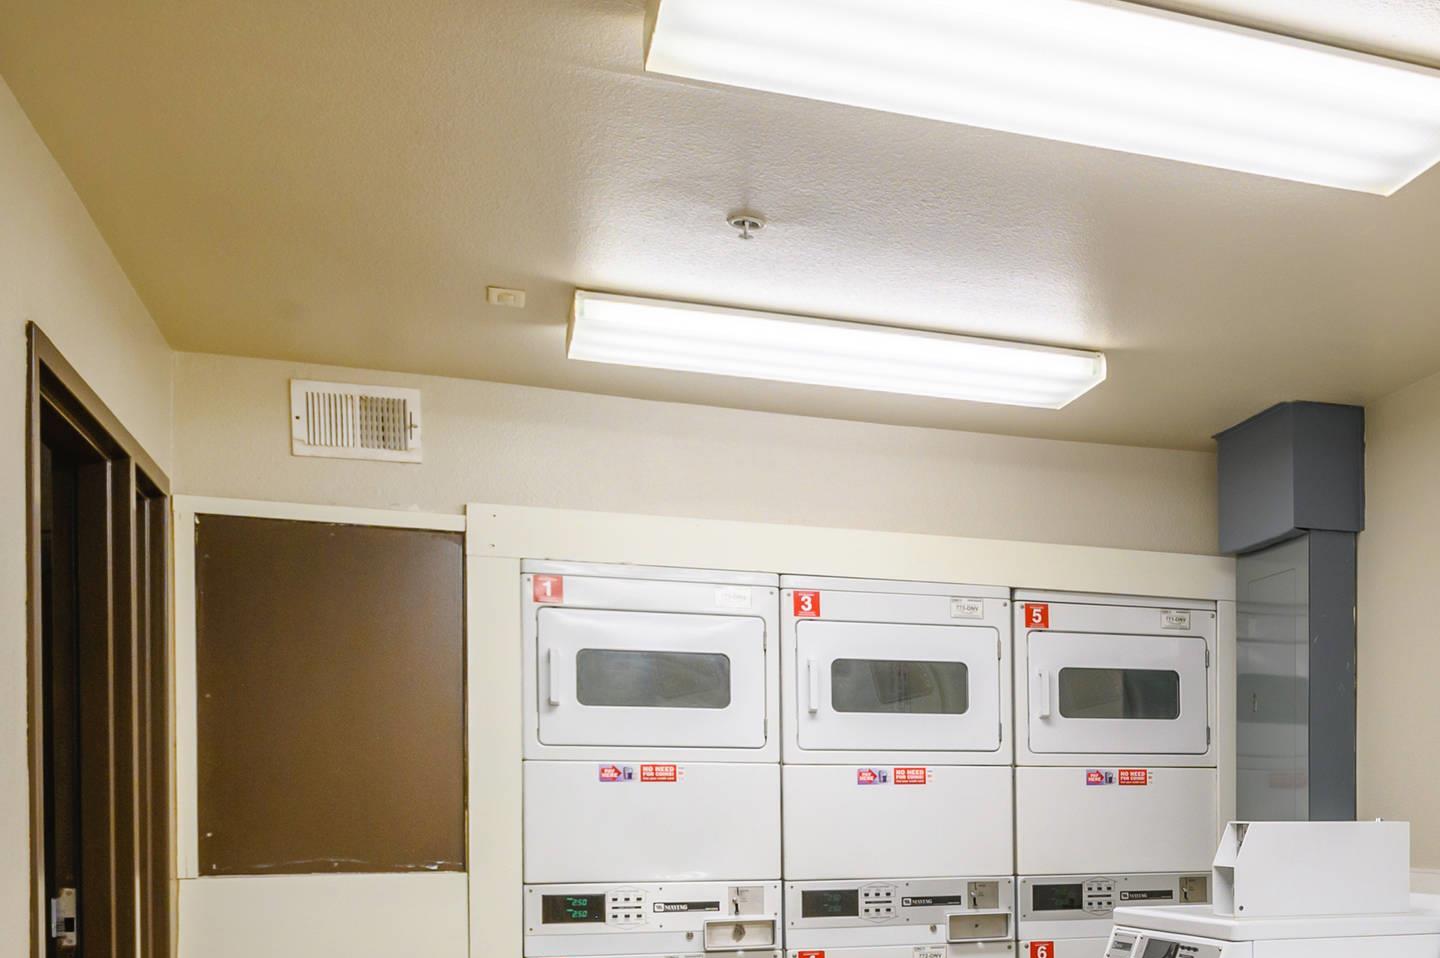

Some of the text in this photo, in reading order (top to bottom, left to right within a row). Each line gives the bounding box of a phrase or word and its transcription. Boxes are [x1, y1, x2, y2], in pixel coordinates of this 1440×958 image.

[543, 580, 552, 597] 1
[801, 595, 812, 611] 3
[1032, 608, 1042, 623] 5
